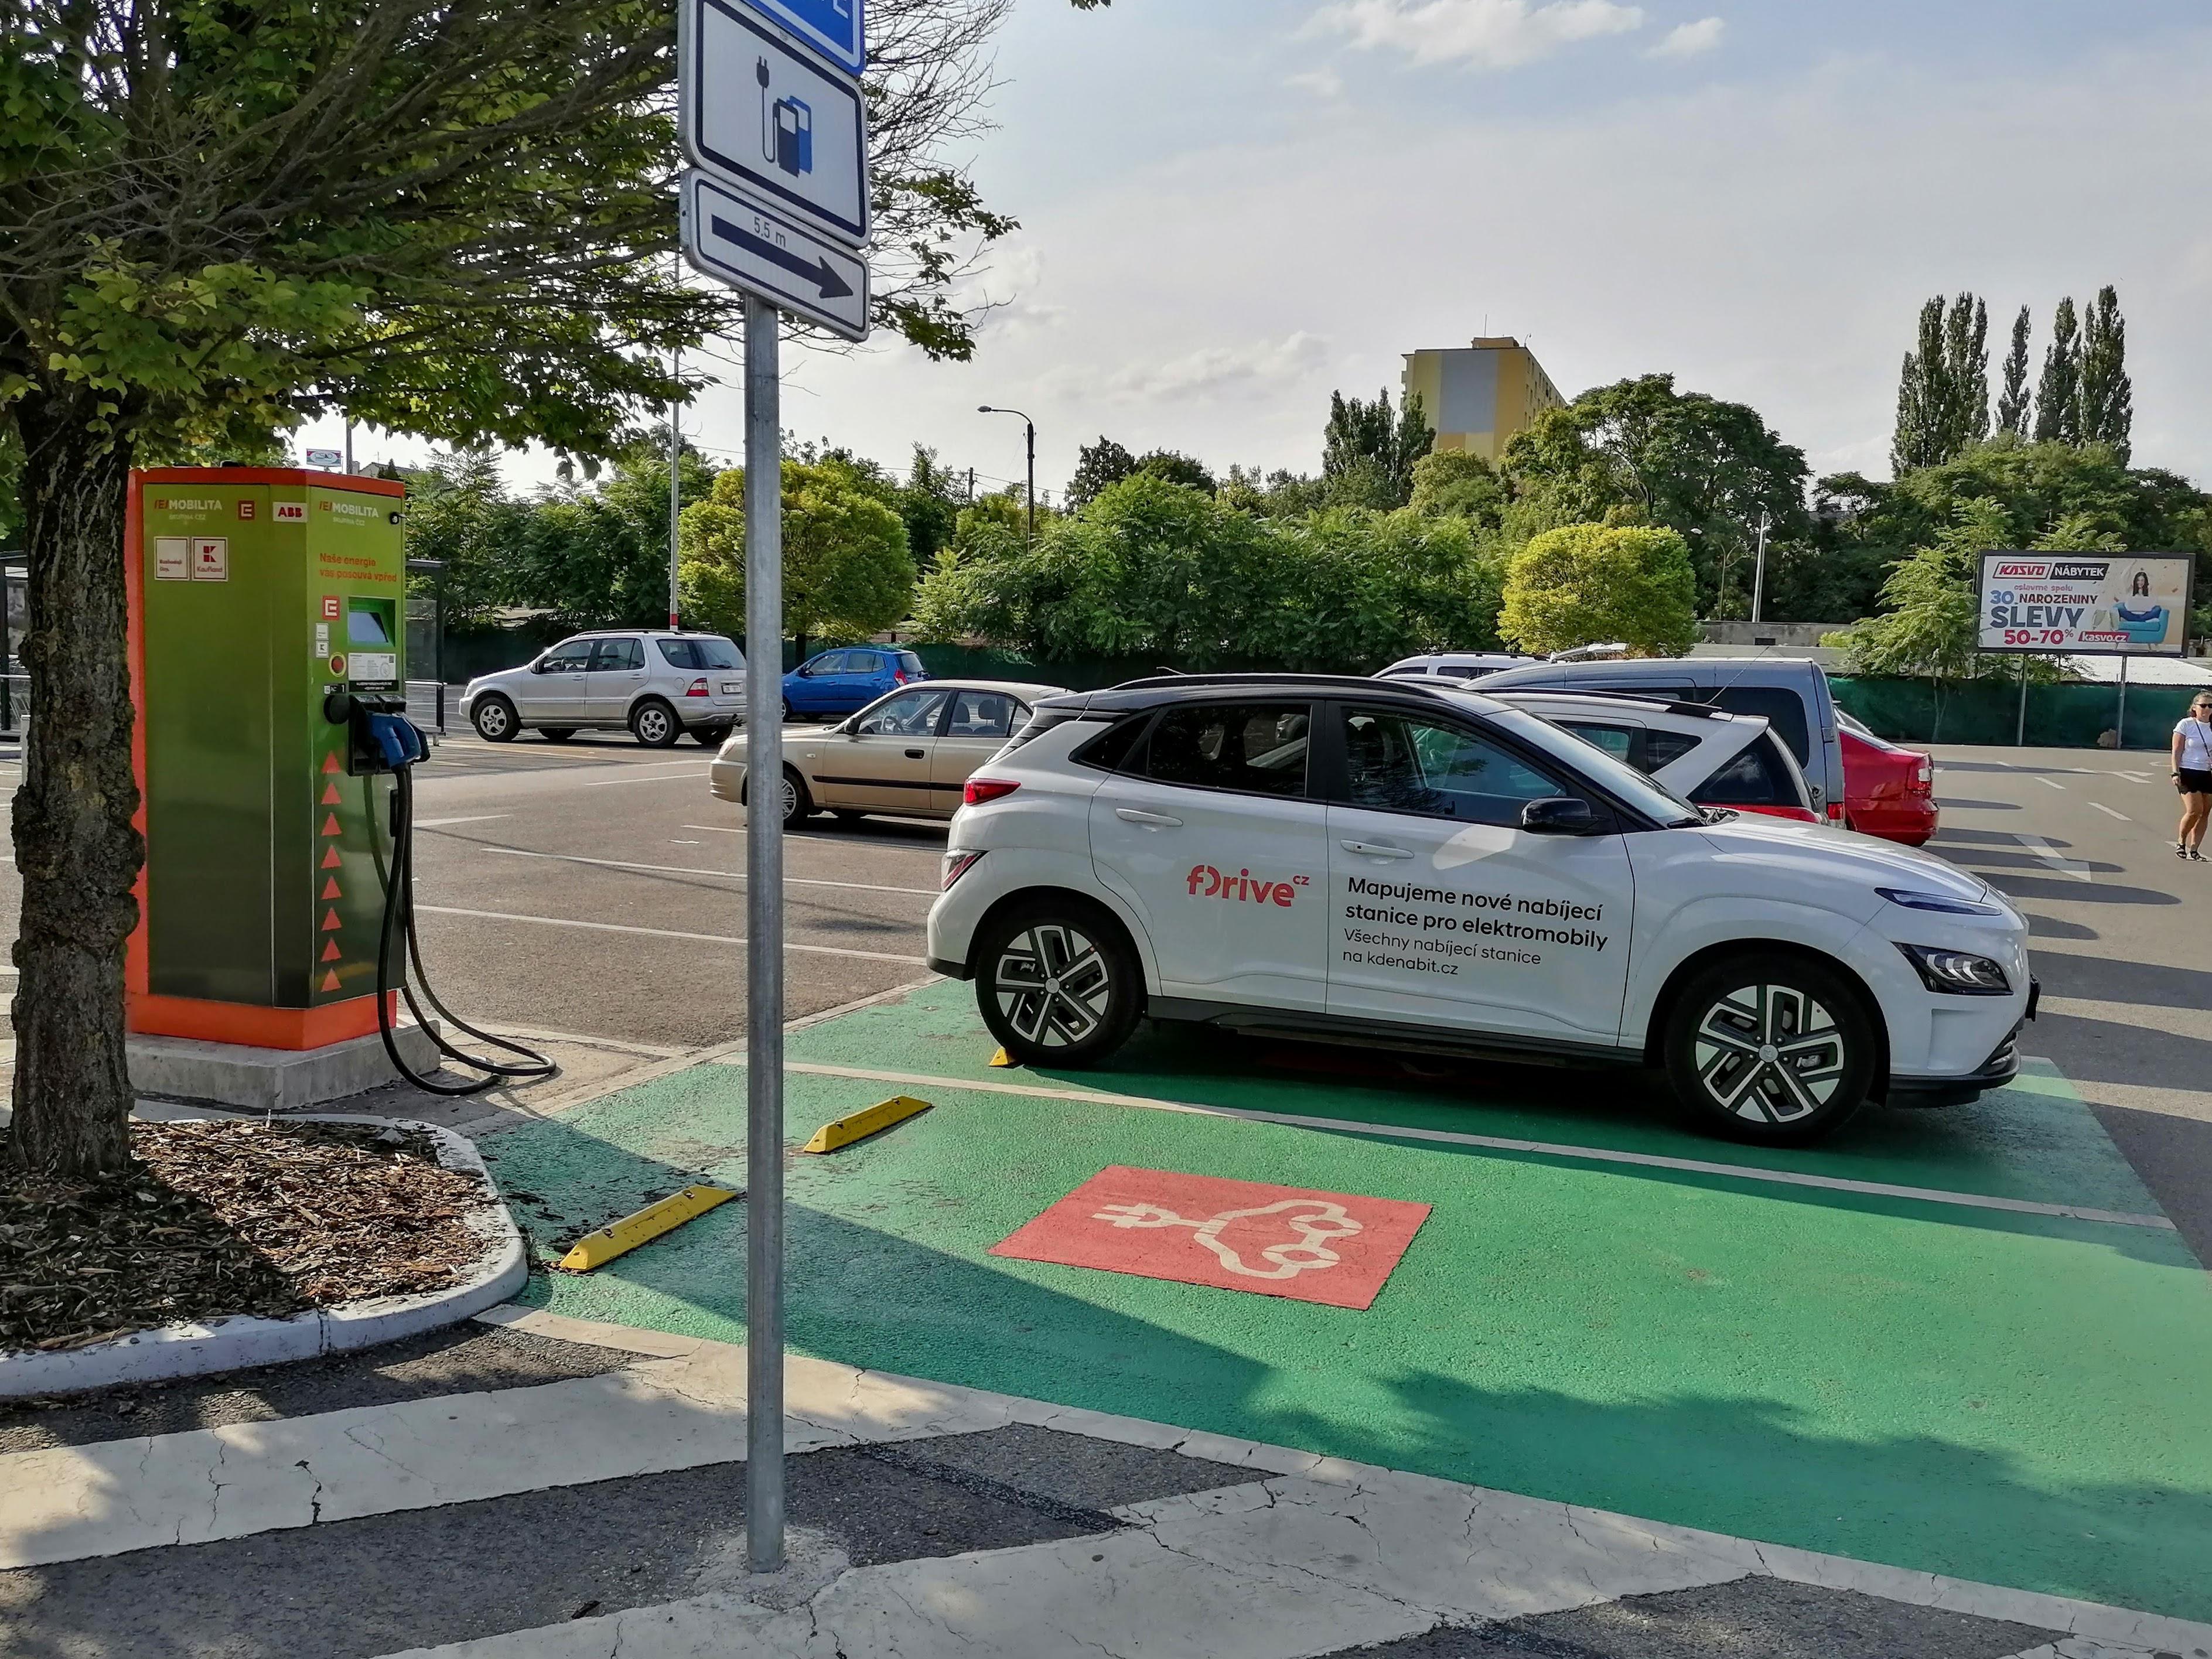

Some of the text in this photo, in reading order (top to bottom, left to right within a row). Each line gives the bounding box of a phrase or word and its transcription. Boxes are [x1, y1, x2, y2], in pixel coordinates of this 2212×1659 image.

[776, 231, 786, 248] m
[278, 507, 302, 517] ABB
[320, 553, 341, 564] Naše
[2054, 565, 2105, 576] NÁBYTEK
[374, 573, 397, 582] vpřed
[2051, 584, 2073, 593] spolu
[2019, 593, 2098, 604] NAROZENINY
[1990, 606, 2085, 629] SLEVY
[2082, 632, 2128, 643] kasvo.cz
[1348, 877, 1603, 921] Mapujeme nové nabíjecí
[1345, 904, 1609, 952] stanice pro elektromobily
[1344, 928, 1541, 965] Všechny nabíjecí stanice
[1343, 951, 1459, 975] na kdenabit.cz
